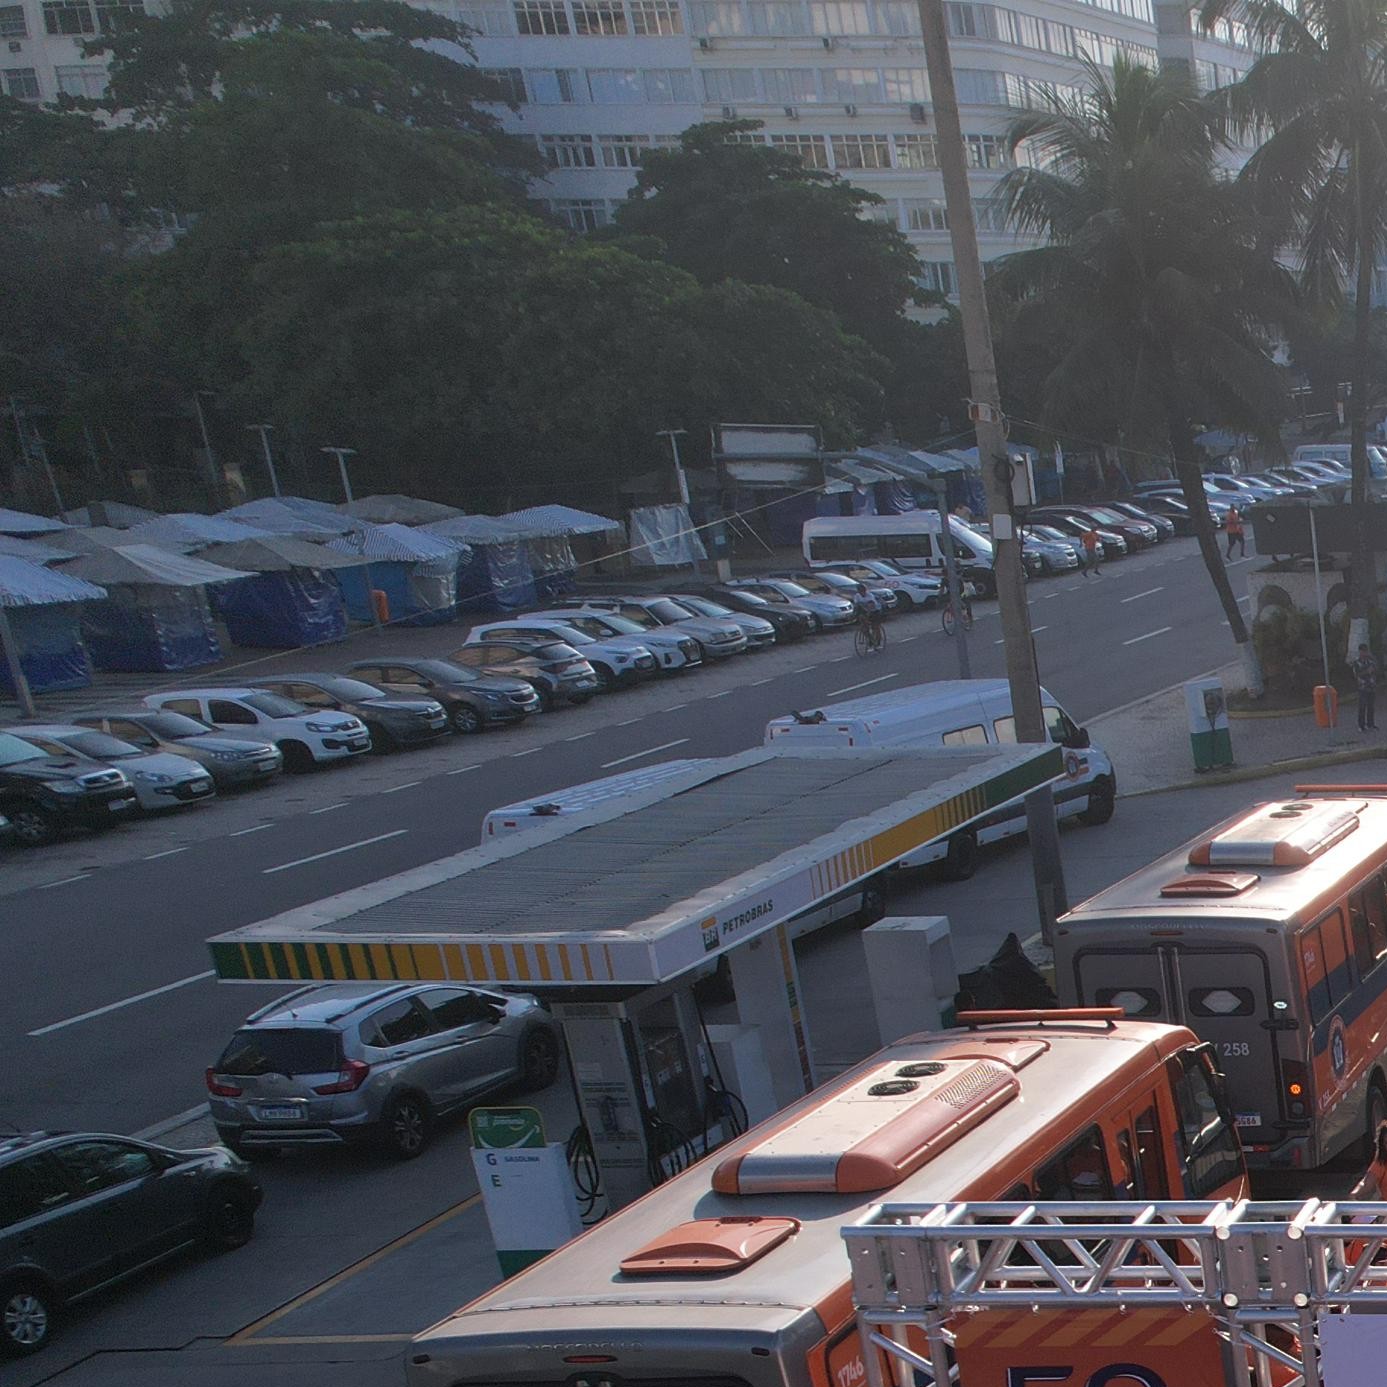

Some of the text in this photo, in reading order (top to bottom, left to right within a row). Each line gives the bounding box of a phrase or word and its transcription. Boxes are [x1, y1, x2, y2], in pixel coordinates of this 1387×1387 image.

[723, 899, 774, 936] PETROBRAS
[1224, 1043, 1250, 1056] 258
[486, 1153, 498, 1166] G
[491, 1175, 503, 1187] E
